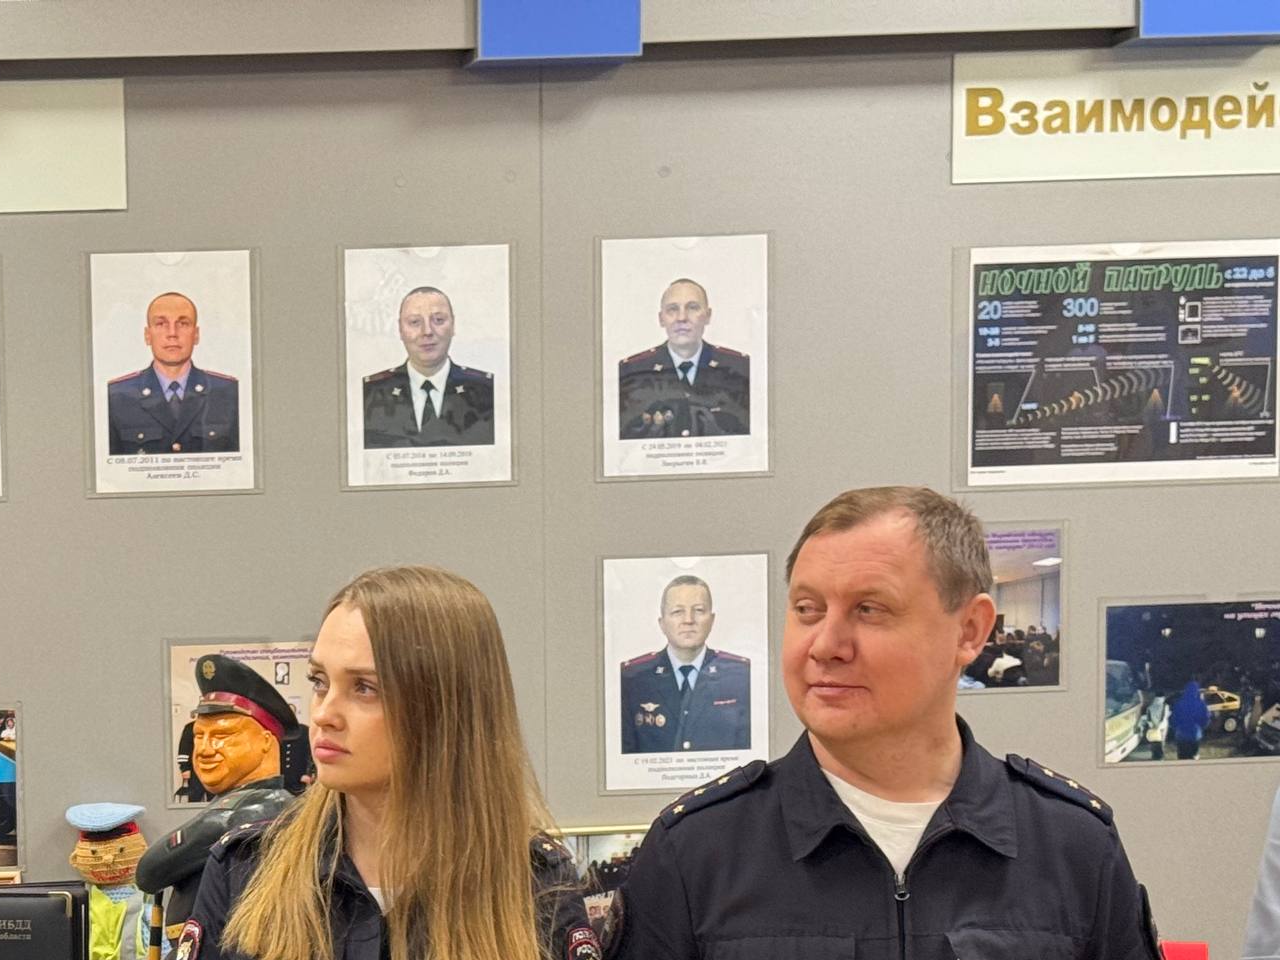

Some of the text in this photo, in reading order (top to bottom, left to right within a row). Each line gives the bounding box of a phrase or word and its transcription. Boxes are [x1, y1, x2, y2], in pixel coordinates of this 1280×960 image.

[965, 81, 1280, 139] Взаимодей
[978, 262, 1223, 296] НОЧНОЙ ПАТРУЛЬ
[977, 300, 1001, 320] 20
[1062, 297, 1099, 318] 300
[0, 931, 32, 940] области
